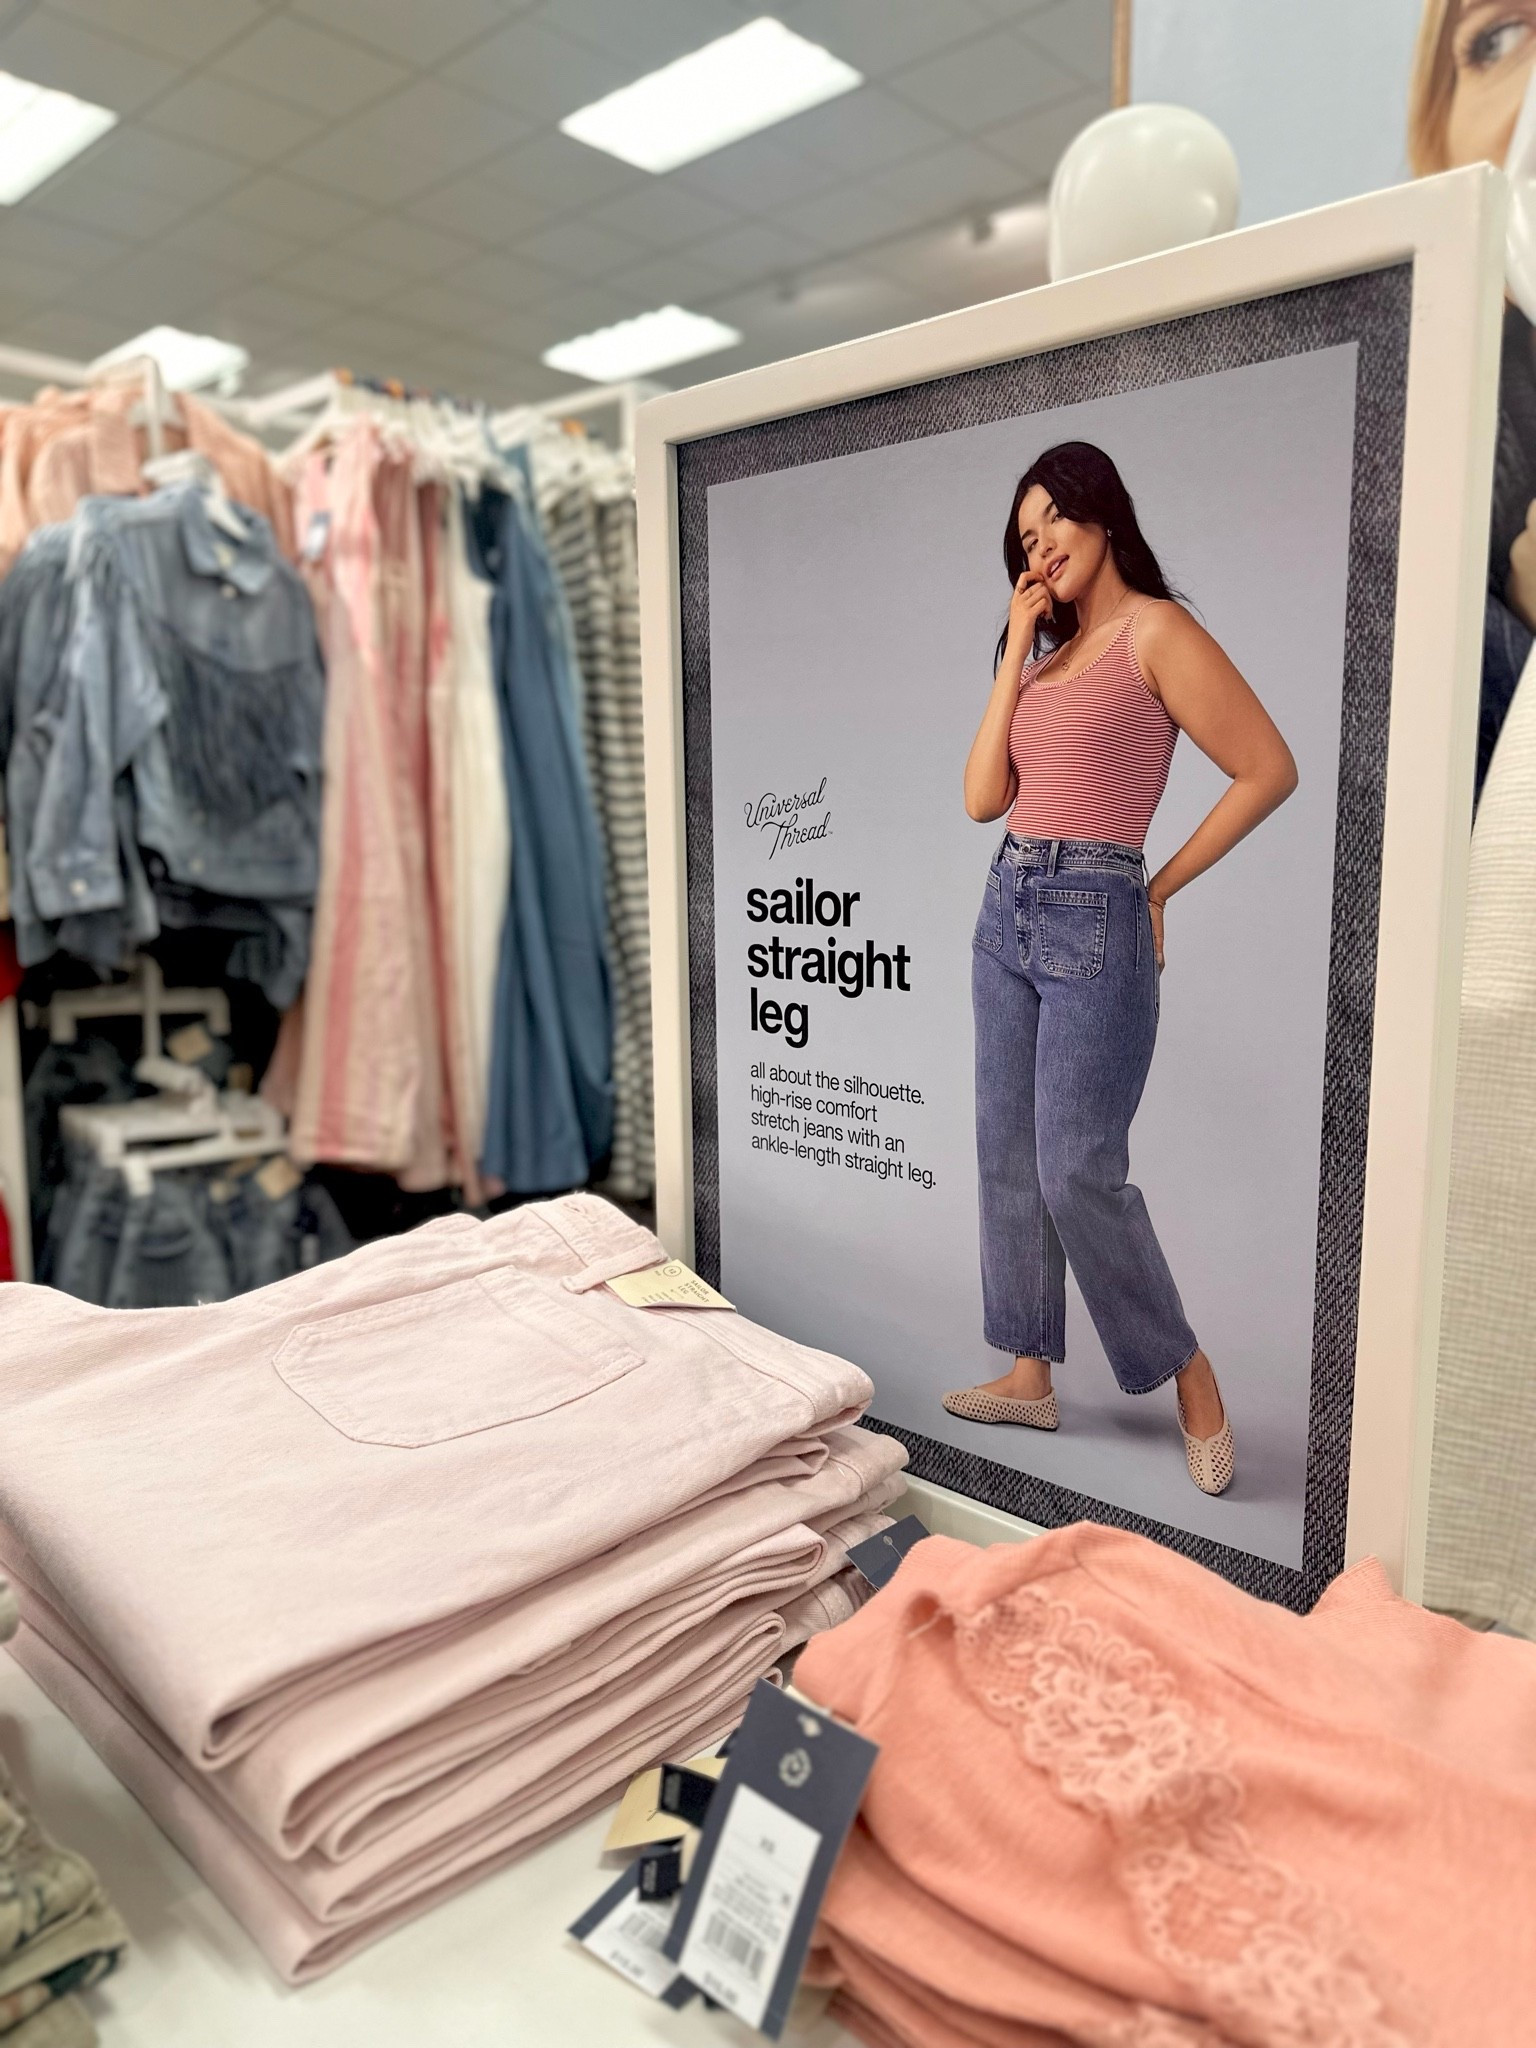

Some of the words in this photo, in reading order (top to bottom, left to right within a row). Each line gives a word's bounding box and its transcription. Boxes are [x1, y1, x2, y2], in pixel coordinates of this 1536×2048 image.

[744, 776, 827, 828] Universal
[760, 812, 831, 860] Thread
[746, 876, 861, 928] sailor
[747, 935, 911, 999] straight
[750, 986, 809, 1049] leg
[751, 1061, 765, 1079] all
[769, 1064, 812, 1087] about
[815, 1070, 840, 1091] the
[844, 1075, 925, 1105] silhouette.
[751, 1084, 812, 1111] high-rise
[816, 1099, 878, 1123] comfort
[751, 1110, 800, 1133] stretch
[803, 1117, 843, 1141] jeans
[847, 1127, 880, 1149] with
[885, 1136, 905, 1154] an
[751, 1134, 841, 1166] ankle-length
[845, 1152, 904, 1180] straight
[908, 1161, 937, 1190] leg.
[678, 1285, 689, 1295] LEG
[684, 1282, 710, 1303] STRAIGHT
[690, 1280, 710, 1295] SAILOR
